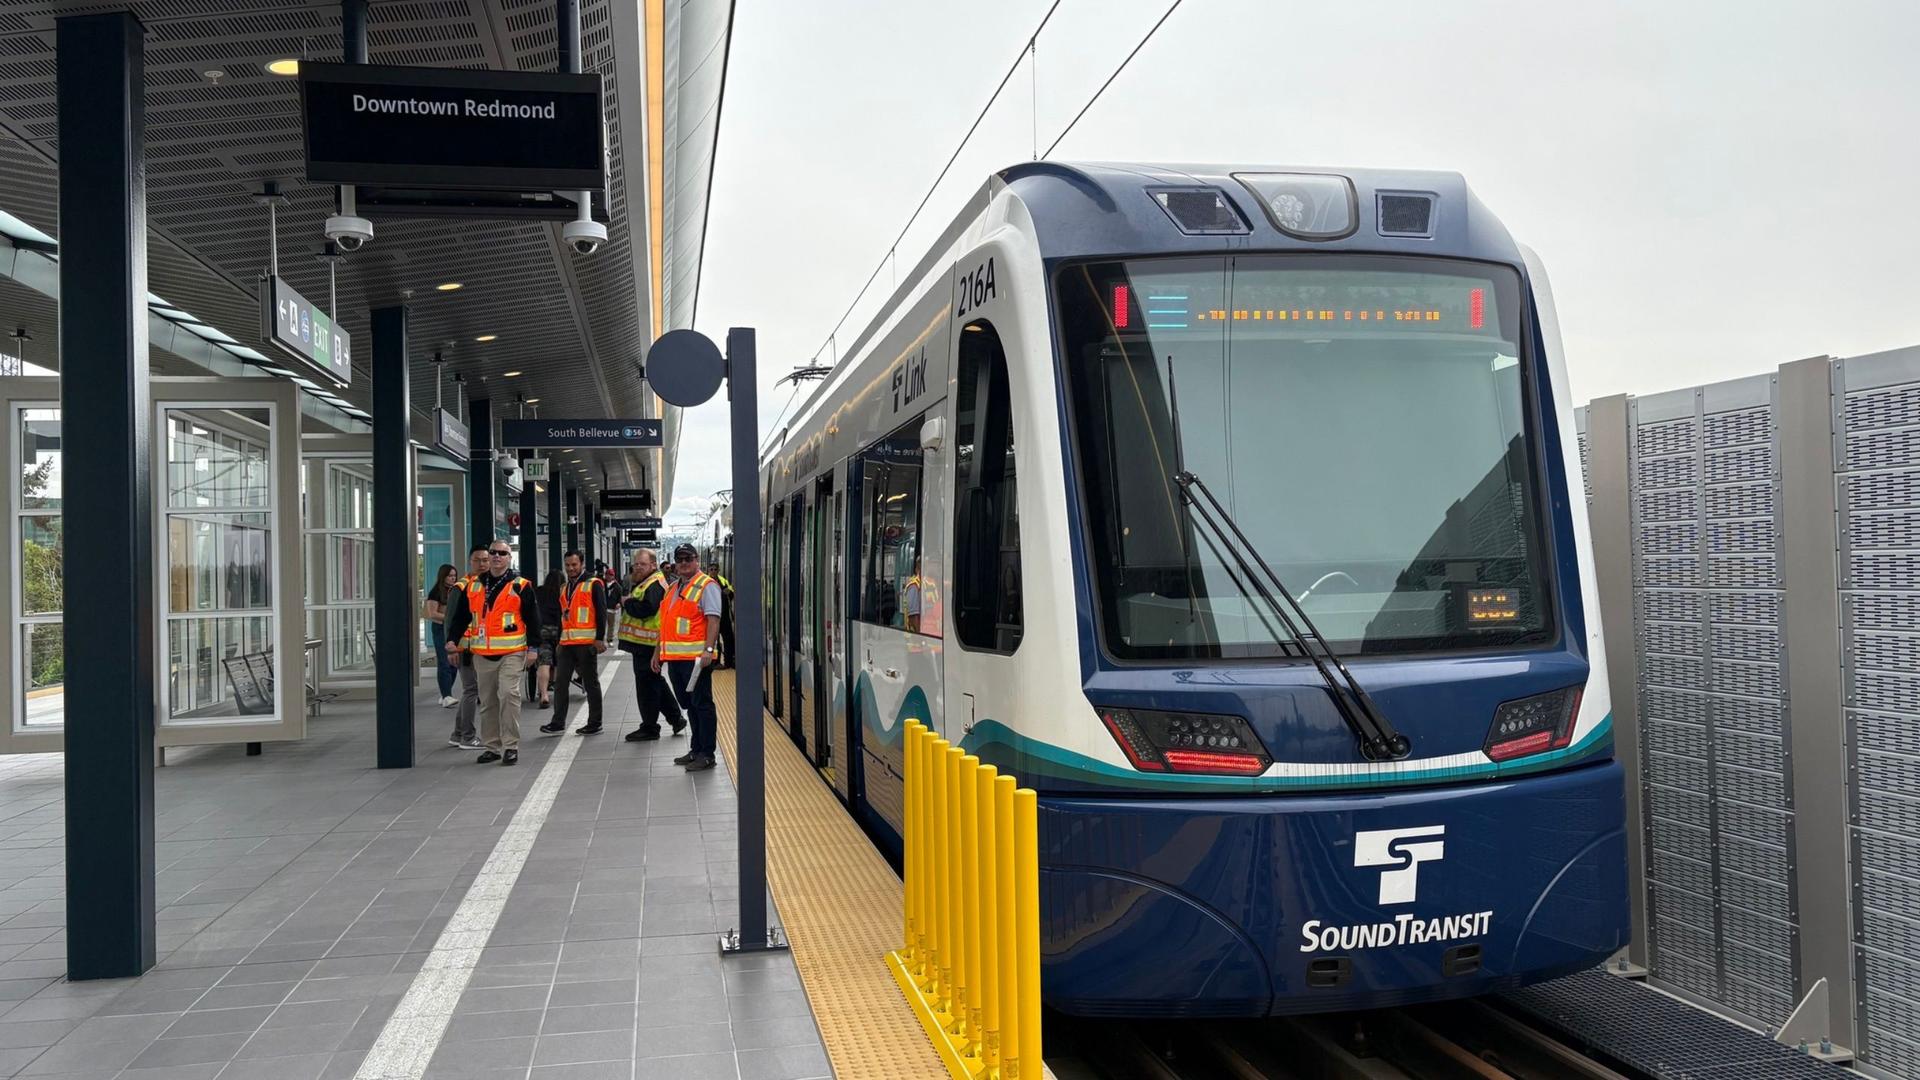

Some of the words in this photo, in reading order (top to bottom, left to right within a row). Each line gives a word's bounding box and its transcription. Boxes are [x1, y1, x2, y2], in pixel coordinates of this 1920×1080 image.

[353, 94, 459, 116] Downtown
[464, 99, 556, 119] Redmond
[958, 257, 996, 318] 216A
[314, 322, 329, 353] EXIT
[904, 346, 928, 406] Link
[548, 427, 576, 438] South
[579, 427, 620, 438] Bellevue
[528, 463, 544, 476] EXIT
